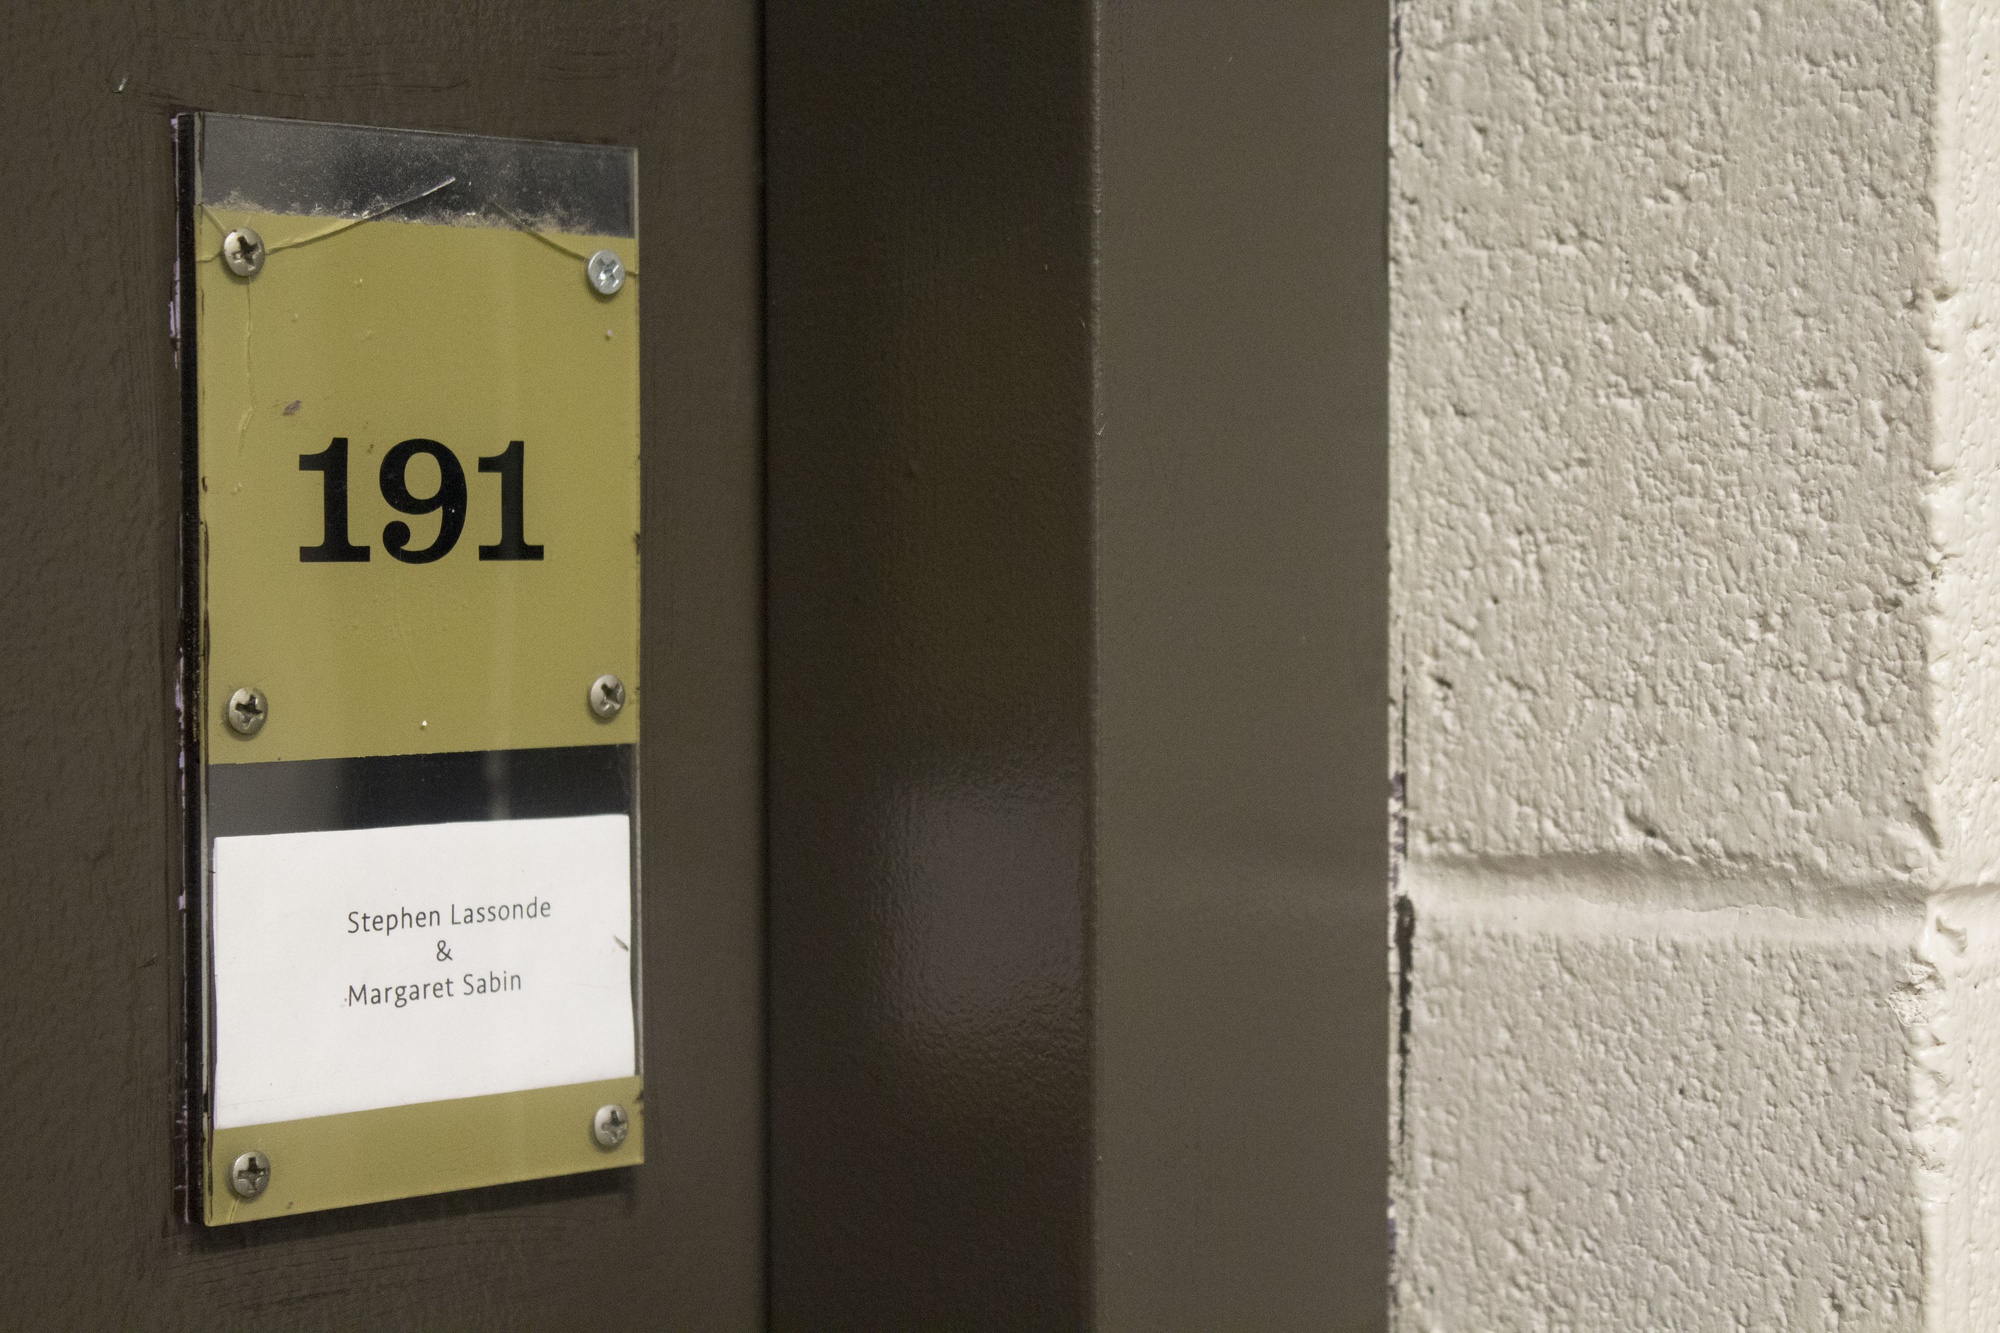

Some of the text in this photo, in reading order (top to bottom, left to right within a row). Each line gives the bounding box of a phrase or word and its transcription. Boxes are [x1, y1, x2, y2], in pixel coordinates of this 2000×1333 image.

[298, 437, 545, 565] 191
[347, 896, 552, 936] Stephen Lassonde
[436, 940, 453, 962] &
[348, 970, 522, 1008] Margaret Sabin
